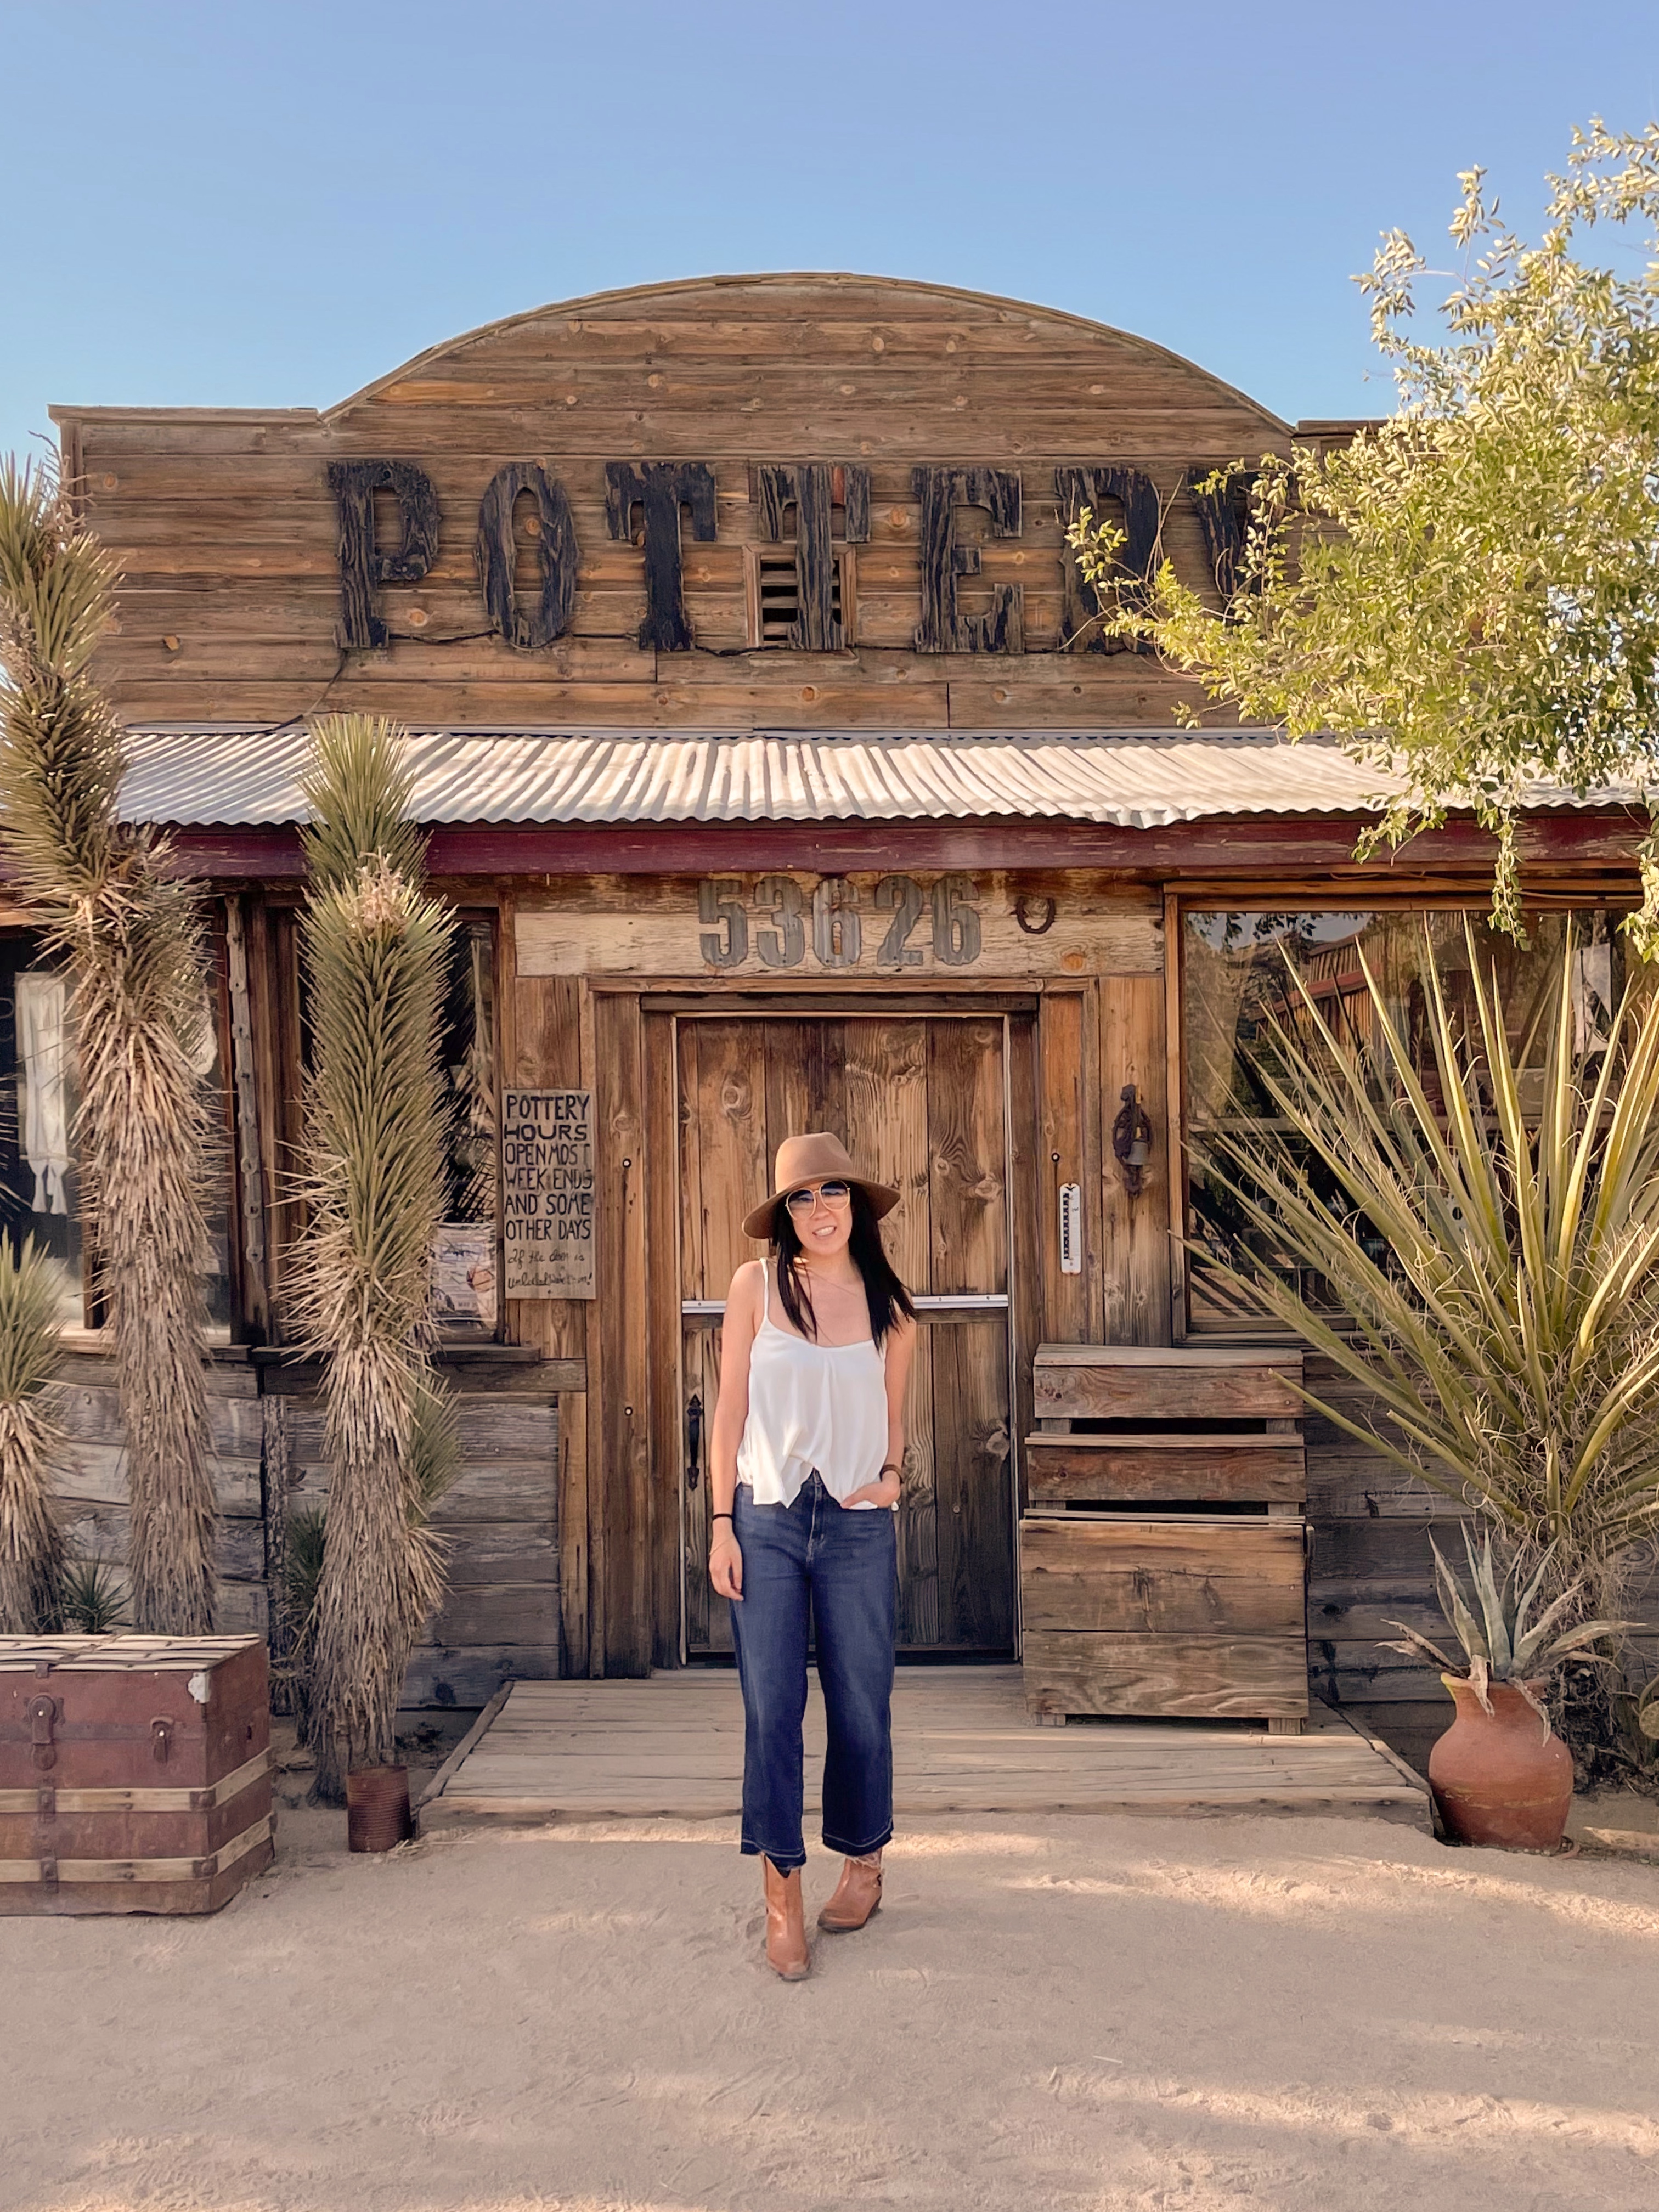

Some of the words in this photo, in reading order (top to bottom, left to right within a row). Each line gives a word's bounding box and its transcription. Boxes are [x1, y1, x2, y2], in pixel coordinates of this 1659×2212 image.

[698, 876, 981, 968] 53626
[506, 1094, 590, 1120] POTTERY
[504, 1124, 588, 1141] HOURS
[505, 1143, 546, 1165] OPEN
[548, 1143, 590, 1165] MOST
[504, 1167, 548, 1190] WEEK
[553, 1168, 592, 1190] ENDS
[504, 1194, 538, 1215] AND
[546, 1193, 591, 1215] SOME
[506, 1218, 551, 1240] OTHER
[558, 1218, 592, 1240] DAYS
